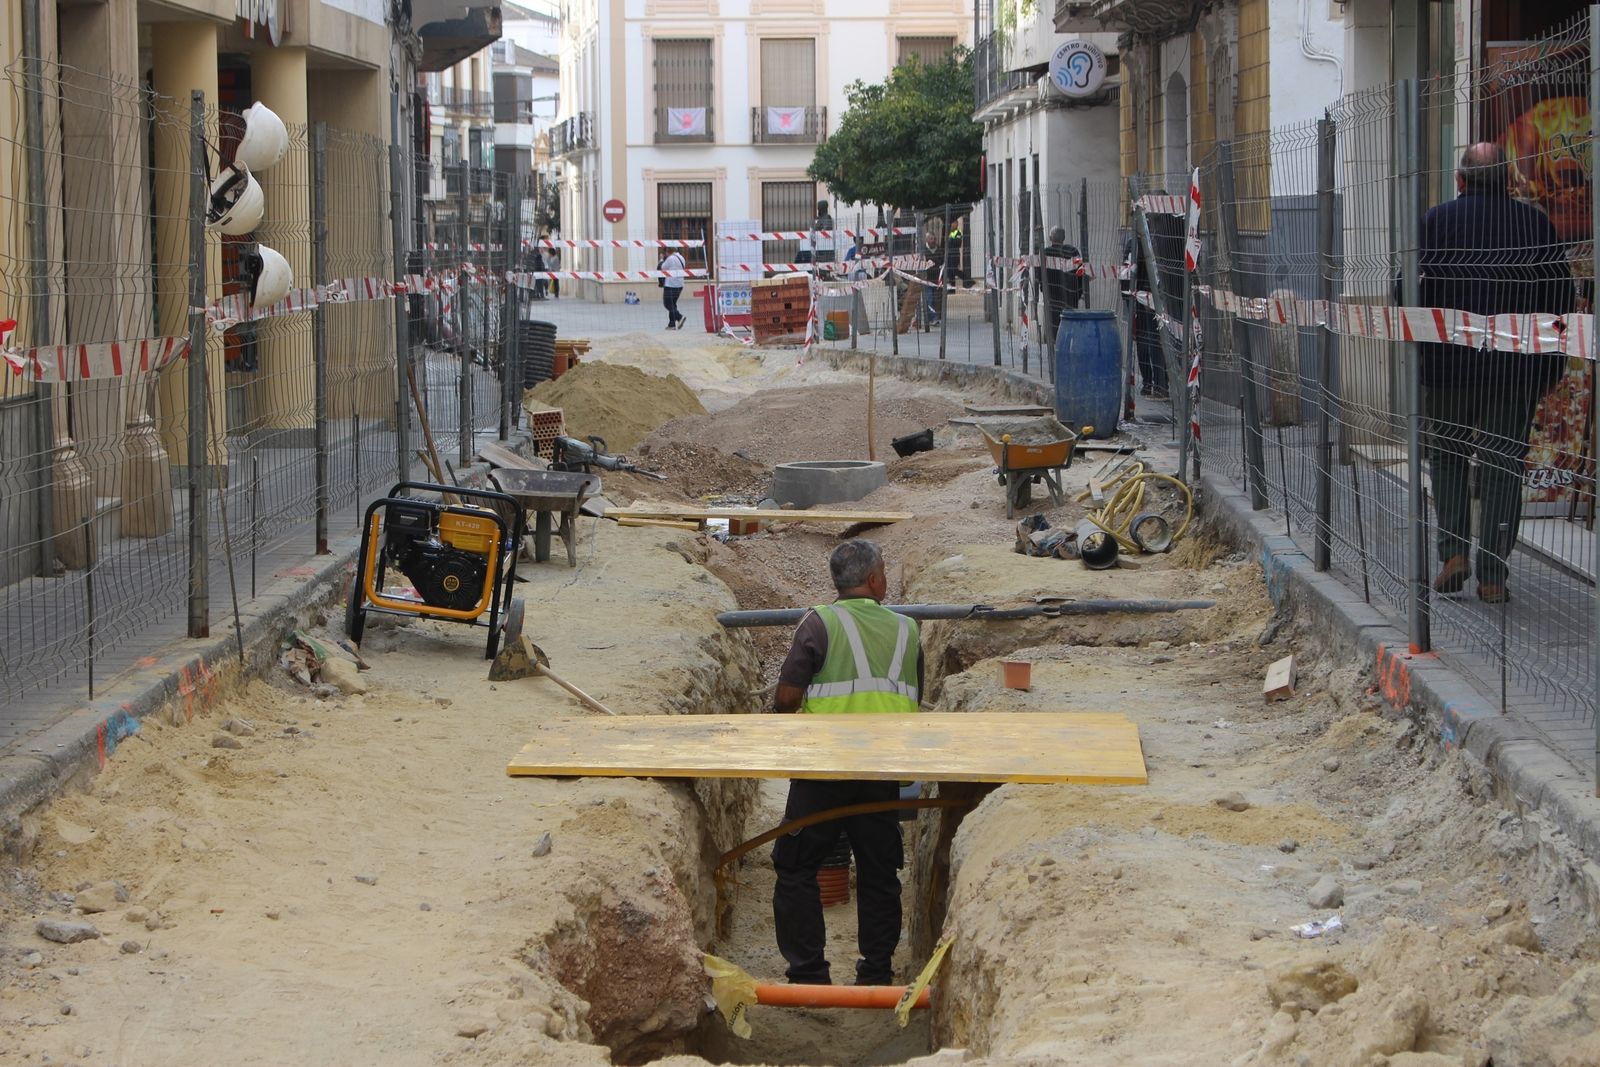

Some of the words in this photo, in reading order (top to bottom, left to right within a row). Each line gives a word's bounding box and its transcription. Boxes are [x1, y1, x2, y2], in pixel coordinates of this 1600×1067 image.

[1056, 43, 1080, 59] CENTRO
[1083, 43, 1104, 69] AUDITIVO
[1503, 60, 1559, 72] TAHONA
[1498, 73, 1526, 86] SAN
[1529, 72, 1588, 86] ANTONIO
